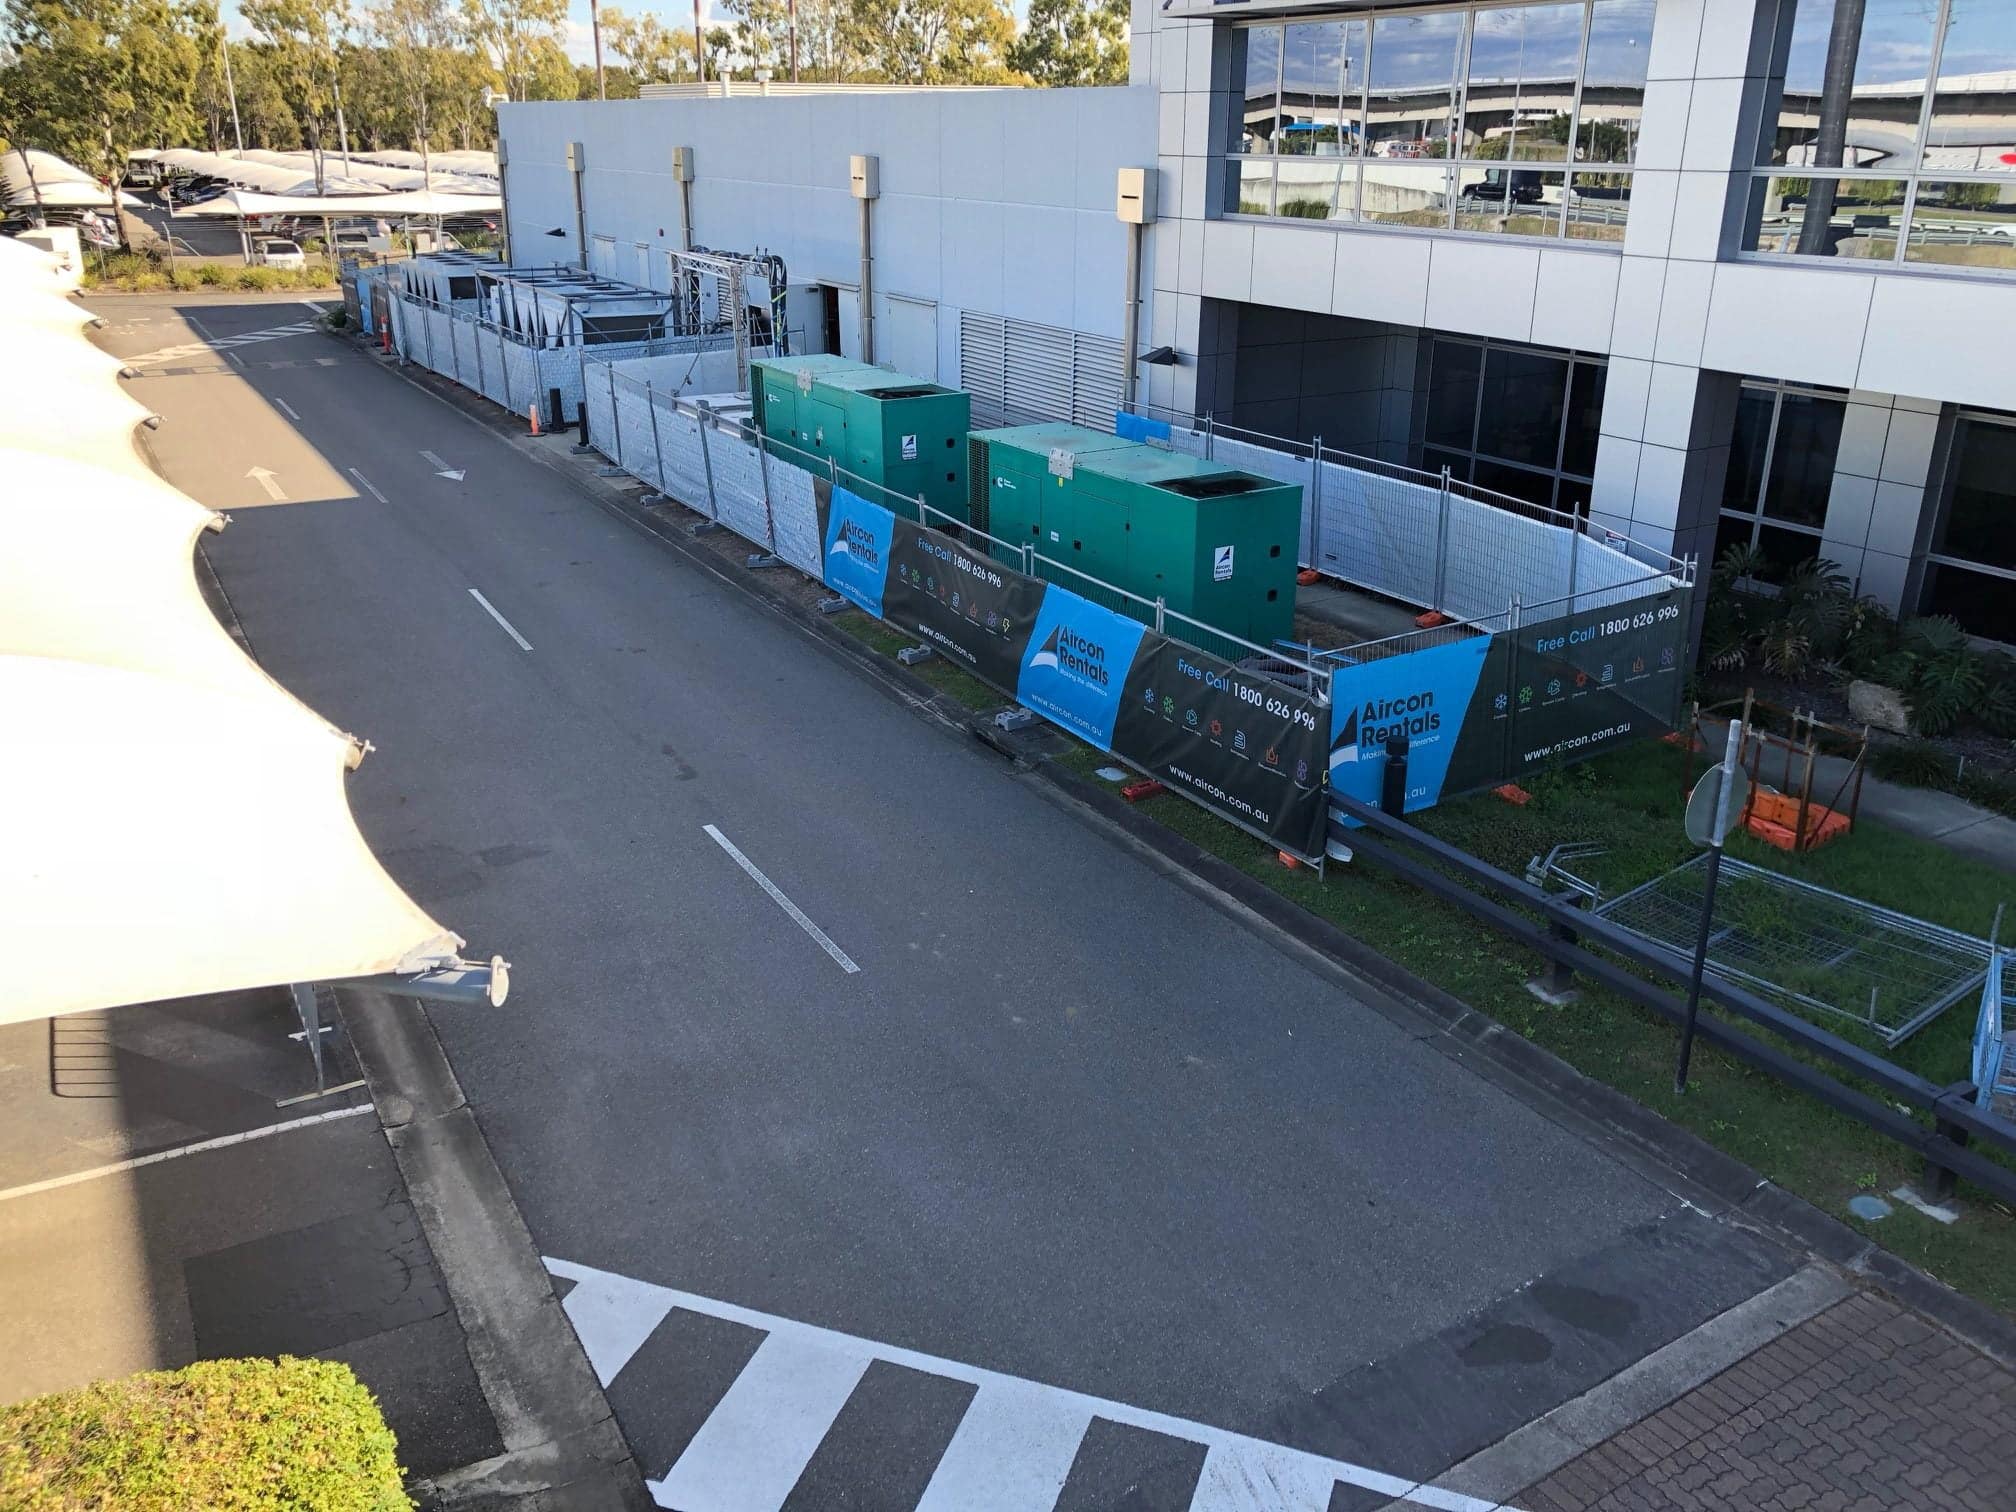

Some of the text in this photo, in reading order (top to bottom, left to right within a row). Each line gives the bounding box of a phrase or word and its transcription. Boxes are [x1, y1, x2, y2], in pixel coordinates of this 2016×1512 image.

[918, 538, 934, 554] Free
[953, 554, 972, 573] 1800
[972, 564, 986, 580] 626
[987, 572, 1001, 588] 996
[1060, 625, 1105, 662] Aircon
[1538, 604, 1679, 653] Free Call 1800 626 996
[1059, 646, 1109, 686] Rentals
[1178, 658, 1315, 731] Free Call 1800 626 996
[1361, 691, 1434, 724] Aircon
[1031, 694, 1103, 737] www.aircon.com.au
[1361, 711, 1441, 748] Rentals
[1361, 750, 1386, 761] Makin
[1524, 722, 1631, 762] www.aircon.com.au
[1169, 764, 1269, 823] www.aircon.com.au
